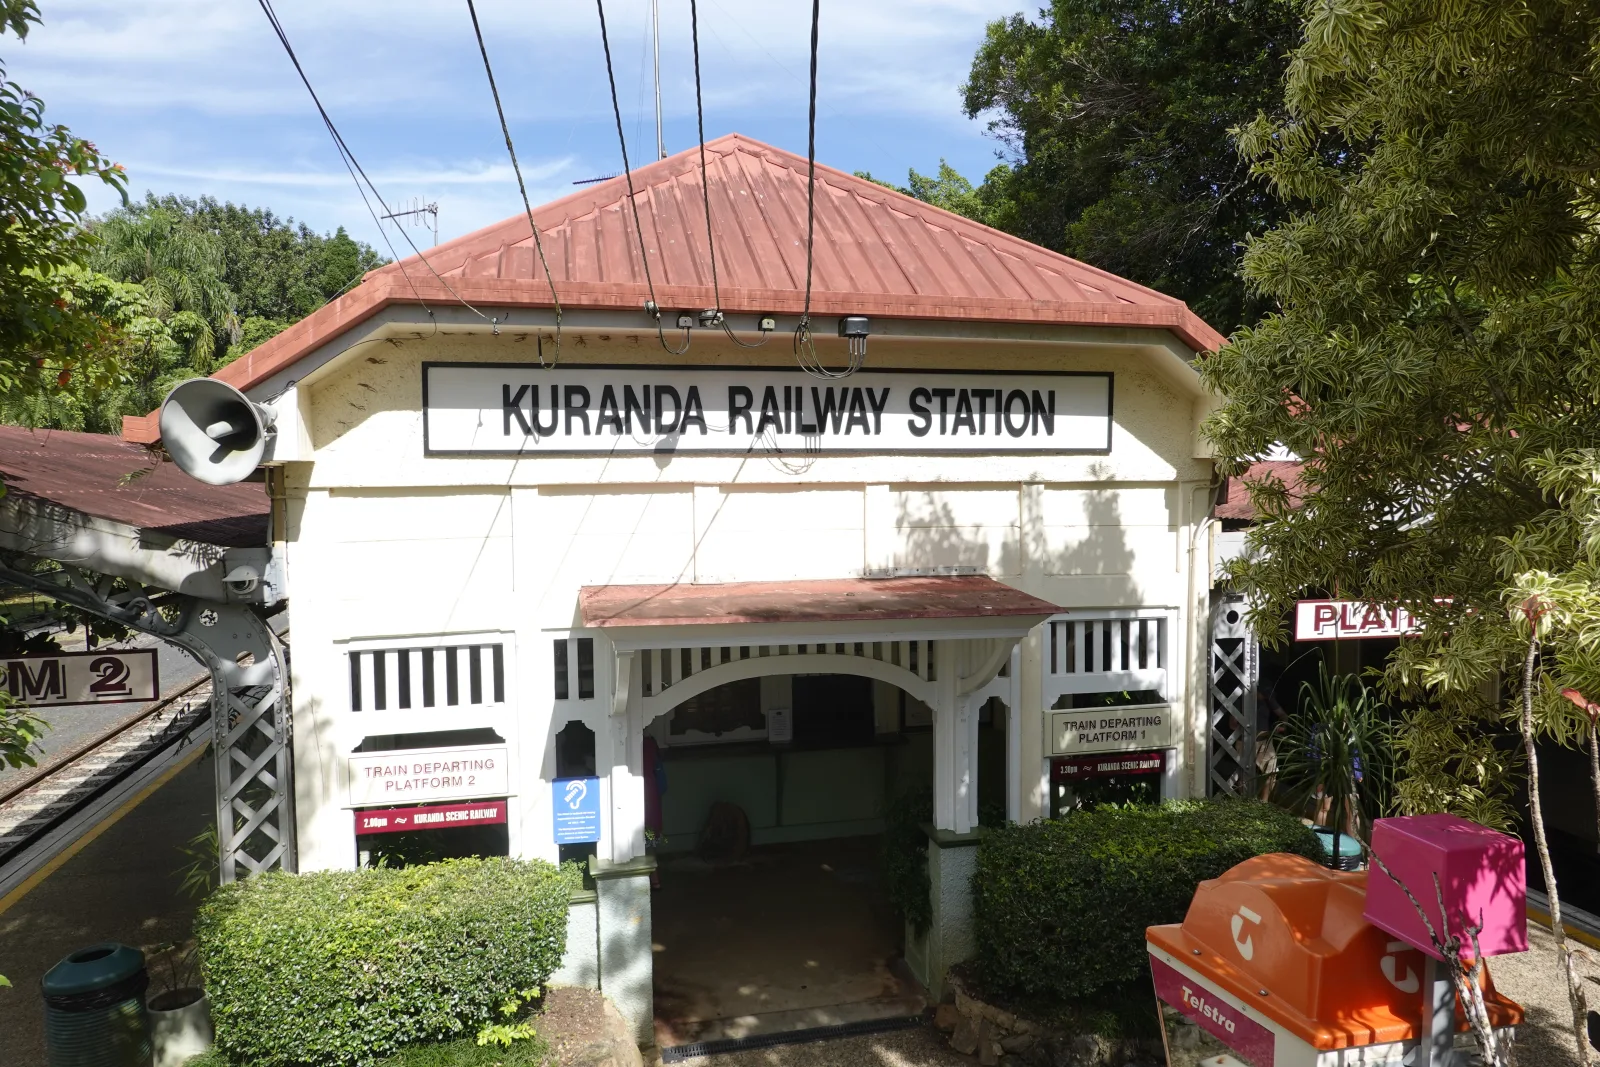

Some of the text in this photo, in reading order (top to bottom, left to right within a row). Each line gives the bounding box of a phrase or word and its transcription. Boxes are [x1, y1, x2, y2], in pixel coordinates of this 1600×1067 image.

[502, 383, 1056, 437] KURANDA RAILWAY STATION
[89, 656, 132, 697] 2
[1063, 716, 1161, 731] TRAIN DEPARTING
[1079, 730, 1146, 743] PLATFORM 1
[365, 759, 494, 777] TRAIN DEPARTING
[386, 776, 475, 790] PLATFORM 2
[413, 812, 445, 824] KURANDA
[445, 810, 469, 821] SCENIC
[469, 807, 498, 819] RAILWAY
[1181, 985, 1236, 1034] Telstra
